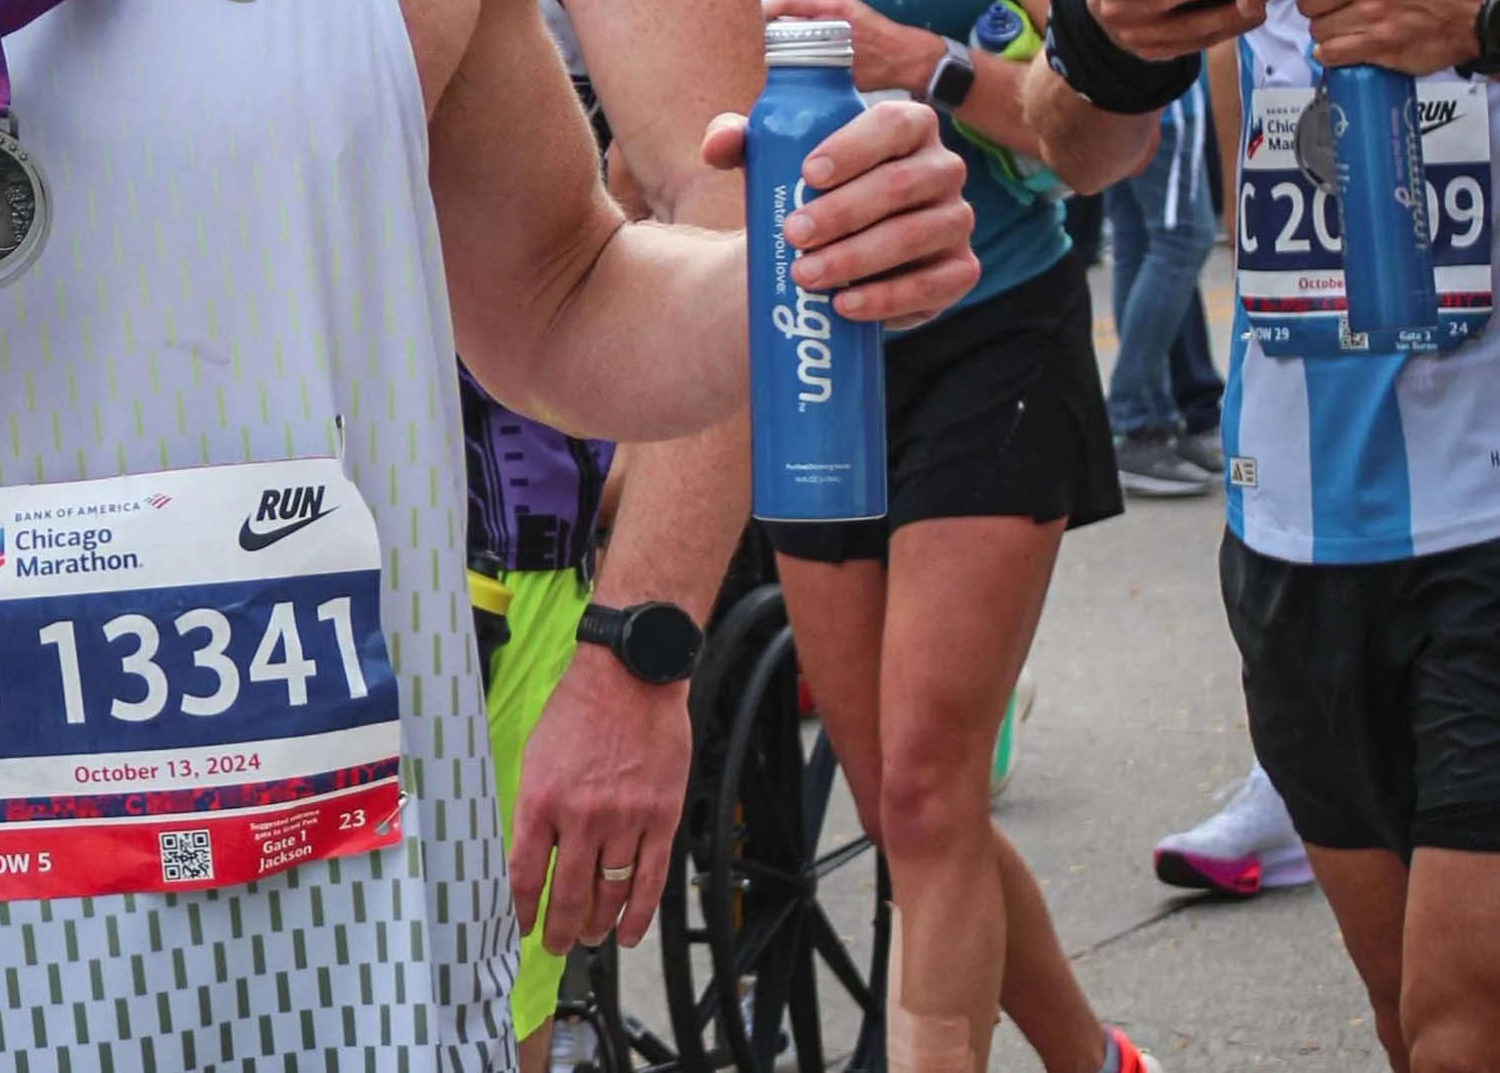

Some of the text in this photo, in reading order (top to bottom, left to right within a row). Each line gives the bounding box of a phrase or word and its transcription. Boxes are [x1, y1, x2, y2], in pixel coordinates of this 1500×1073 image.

[772, 232, 787, 259] you
[1298, 276, 1344, 290] Octobe
[1274, 326, 1290, 341] 29
[15, 501, 141, 523] BANK OF AMERICA
[256, 485, 326, 522] RUN
[15, 527, 113, 551] Chicago
[39, 596, 368, 725] 13341
[74, 752, 261, 784] October 13, 2024
[339, 808, 366, 831] 23
[263, 829, 307, 854] Gate 1
[38, 852, 52, 872] 5
[258, 845, 312, 874] Jackson
